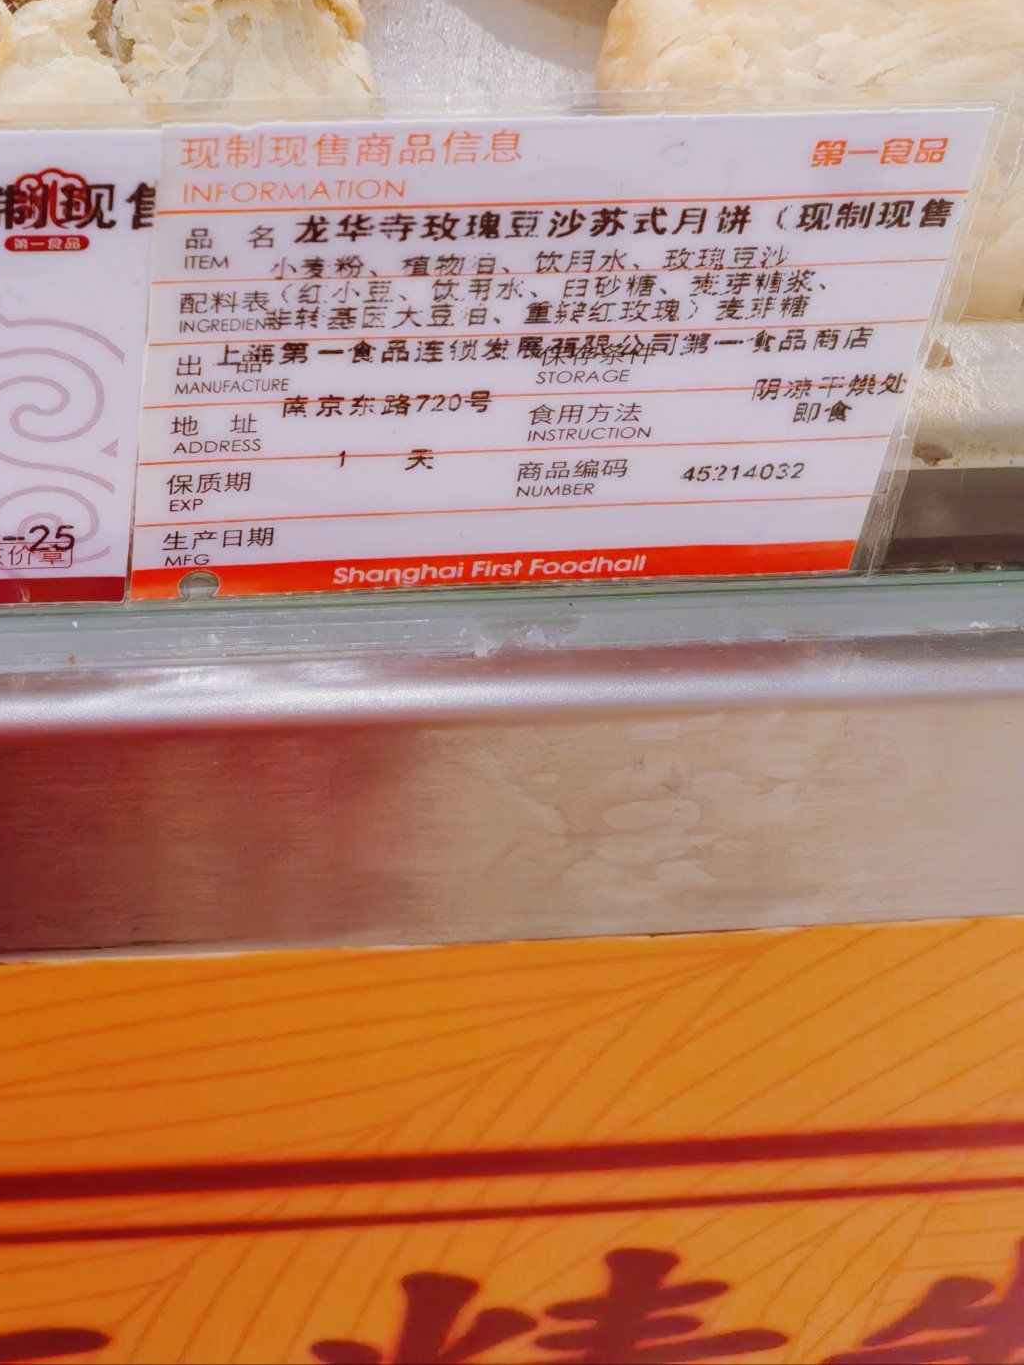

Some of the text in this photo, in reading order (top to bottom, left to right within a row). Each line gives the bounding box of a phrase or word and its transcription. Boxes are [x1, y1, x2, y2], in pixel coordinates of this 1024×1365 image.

[180, 130, 523, 169] 现制现售商品信息
[810, 137, 949, 168] 第一食品
[182, 179, 407, 204] INFORMATION
[294, 198, 966, 244] 龙华寺玫瑰豆沙苏式月饼（现制现售
[184, 255, 229, 270] ITEM
[179, 290, 270, 314] 配料表
[175, 378, 290, 394] MANUFACTURE
[536, 369, 630, 385] STORAGE
[282, 390, 492, 419] 南京东路720号
[528, 403, 642, 425] 食用方法
[792, 400, 852, 423] 即食
[527, 426, 652, 442] INSTRUCTION
[173, 438, 261, 454] ADDRESS
[517, 458, 628, 480] 商品编码
[680, 462, 805, 483] 45214032
[166, 472, 252, 495] 保质期
[517, 482, 594, 497] NUMBER
[169, 498, 204, 512] EXP
[162, 528, 275, 552] 生产日期
[165, 554, 210, 567] MFG
[333, 555, 646, 585] Shanghai First Foodhall
